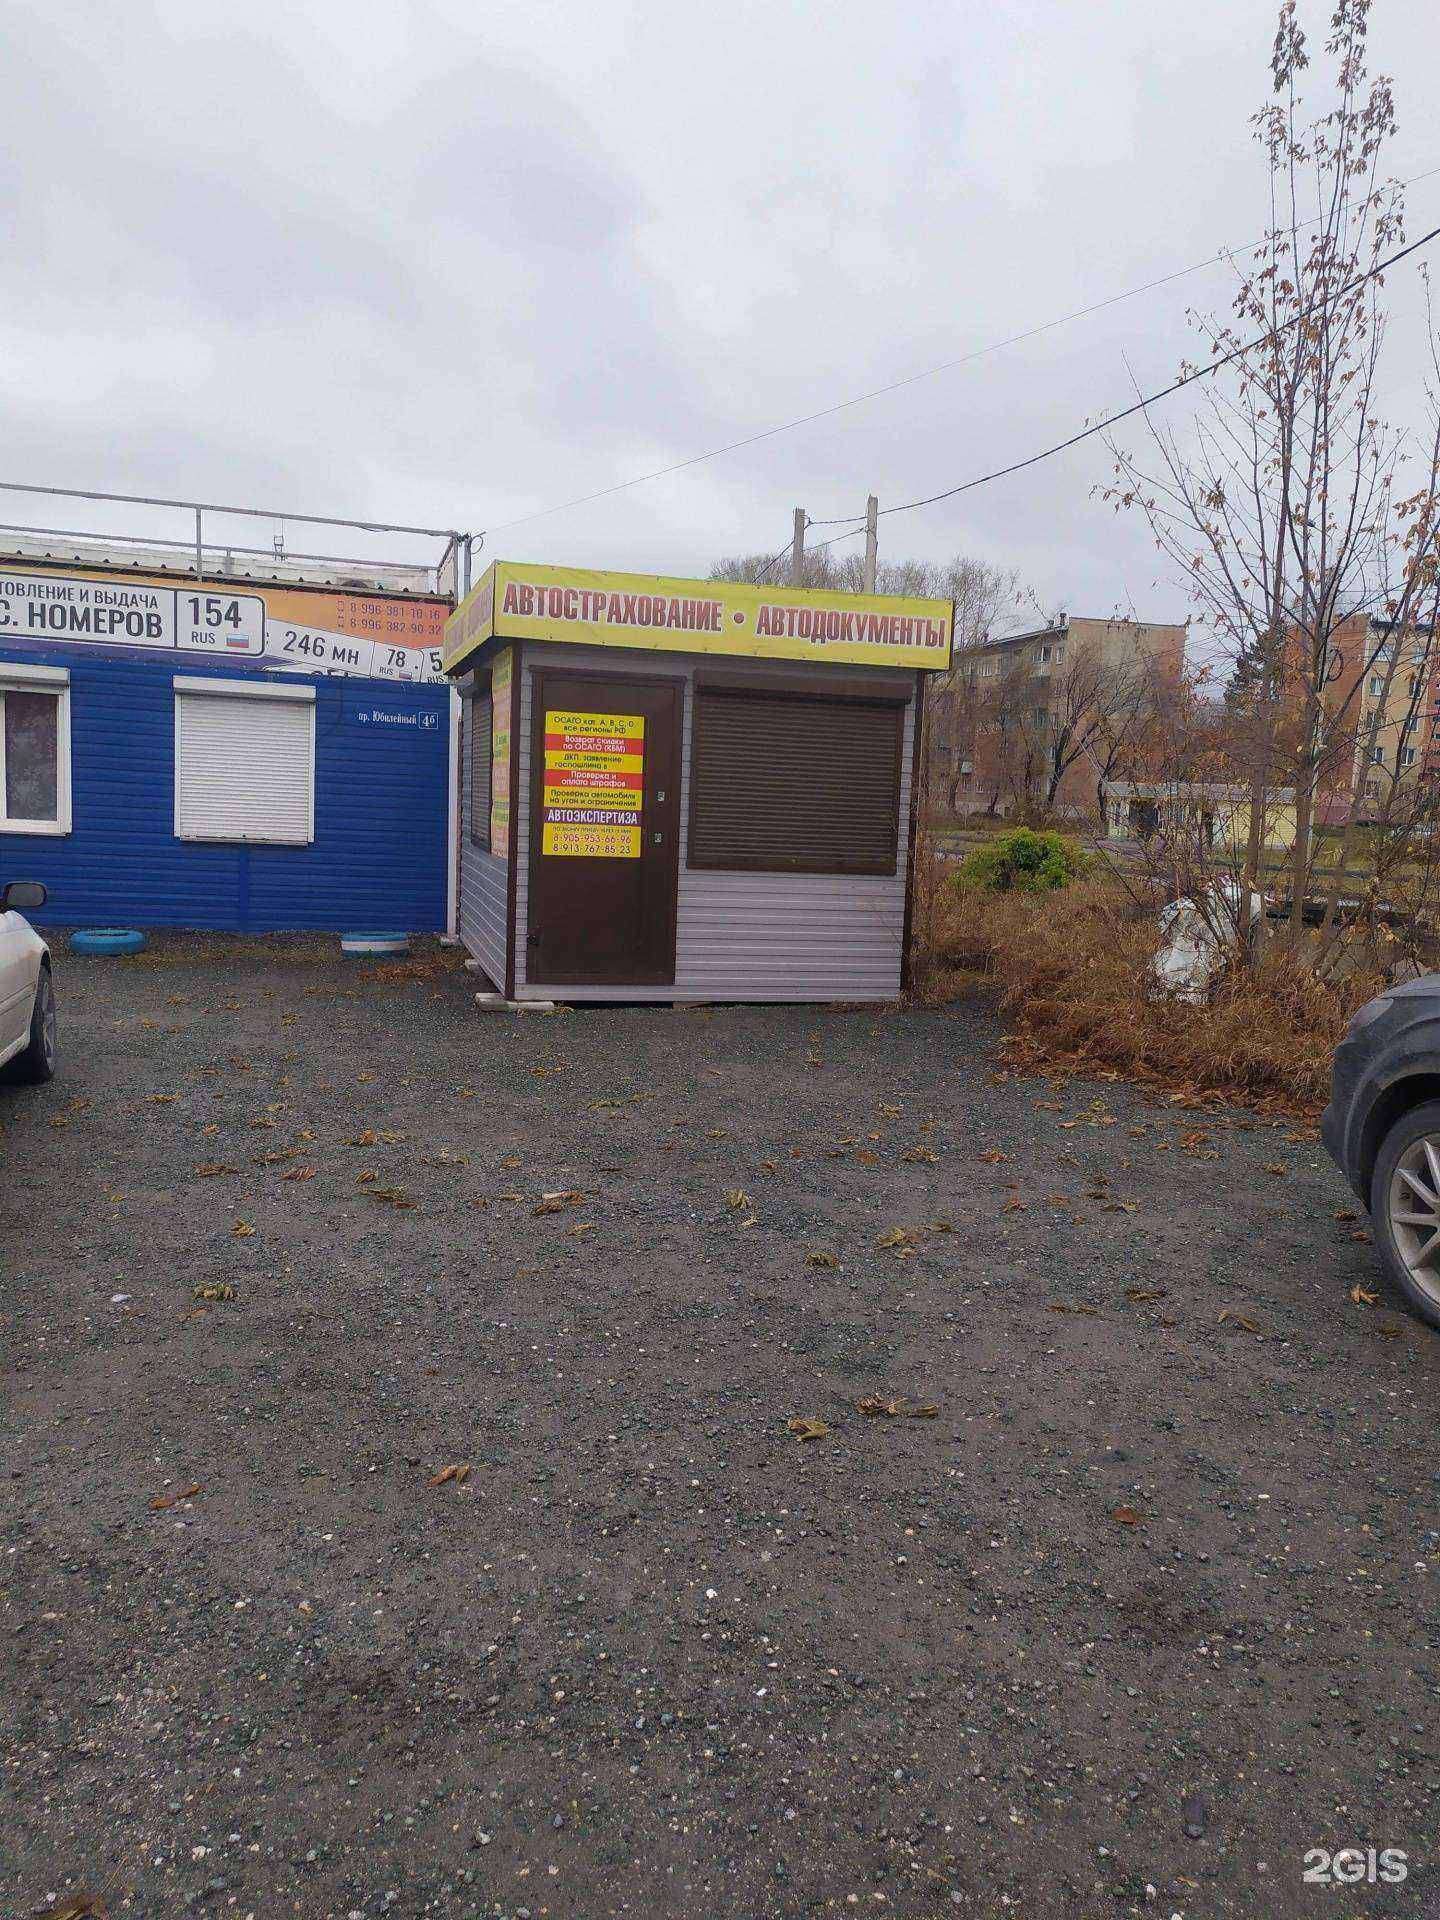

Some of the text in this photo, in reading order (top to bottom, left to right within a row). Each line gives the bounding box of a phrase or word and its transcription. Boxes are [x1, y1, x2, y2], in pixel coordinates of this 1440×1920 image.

[80, 589, 89, 603] И
[94, 590, 159, 609] ВЫДАЧА
[28, 602, 163, 638] НОМЕРОВ
[188, 597, 242, 629] 154
[503, 583, 723, 632] АВТОСТРАХОВАНИЕ
[756, 605, 946, 647] АВТОДОКУМЕНТЫ
[191, 631, 216, 644] RUS
[283, 630, 326, 657] 246
[387, 648, 407, 668] 78
[379, 666, 394, 676] RUS
[358, 712, 370, 723] пр.
[372, 710, 417, 725] Юбилейный
[561, 778, 626, 789] оплата штрафов
[571, 770, 610, 780] Проверка
[548, 809, 638, 824] АВТОЭКСПЕРТИЗА
